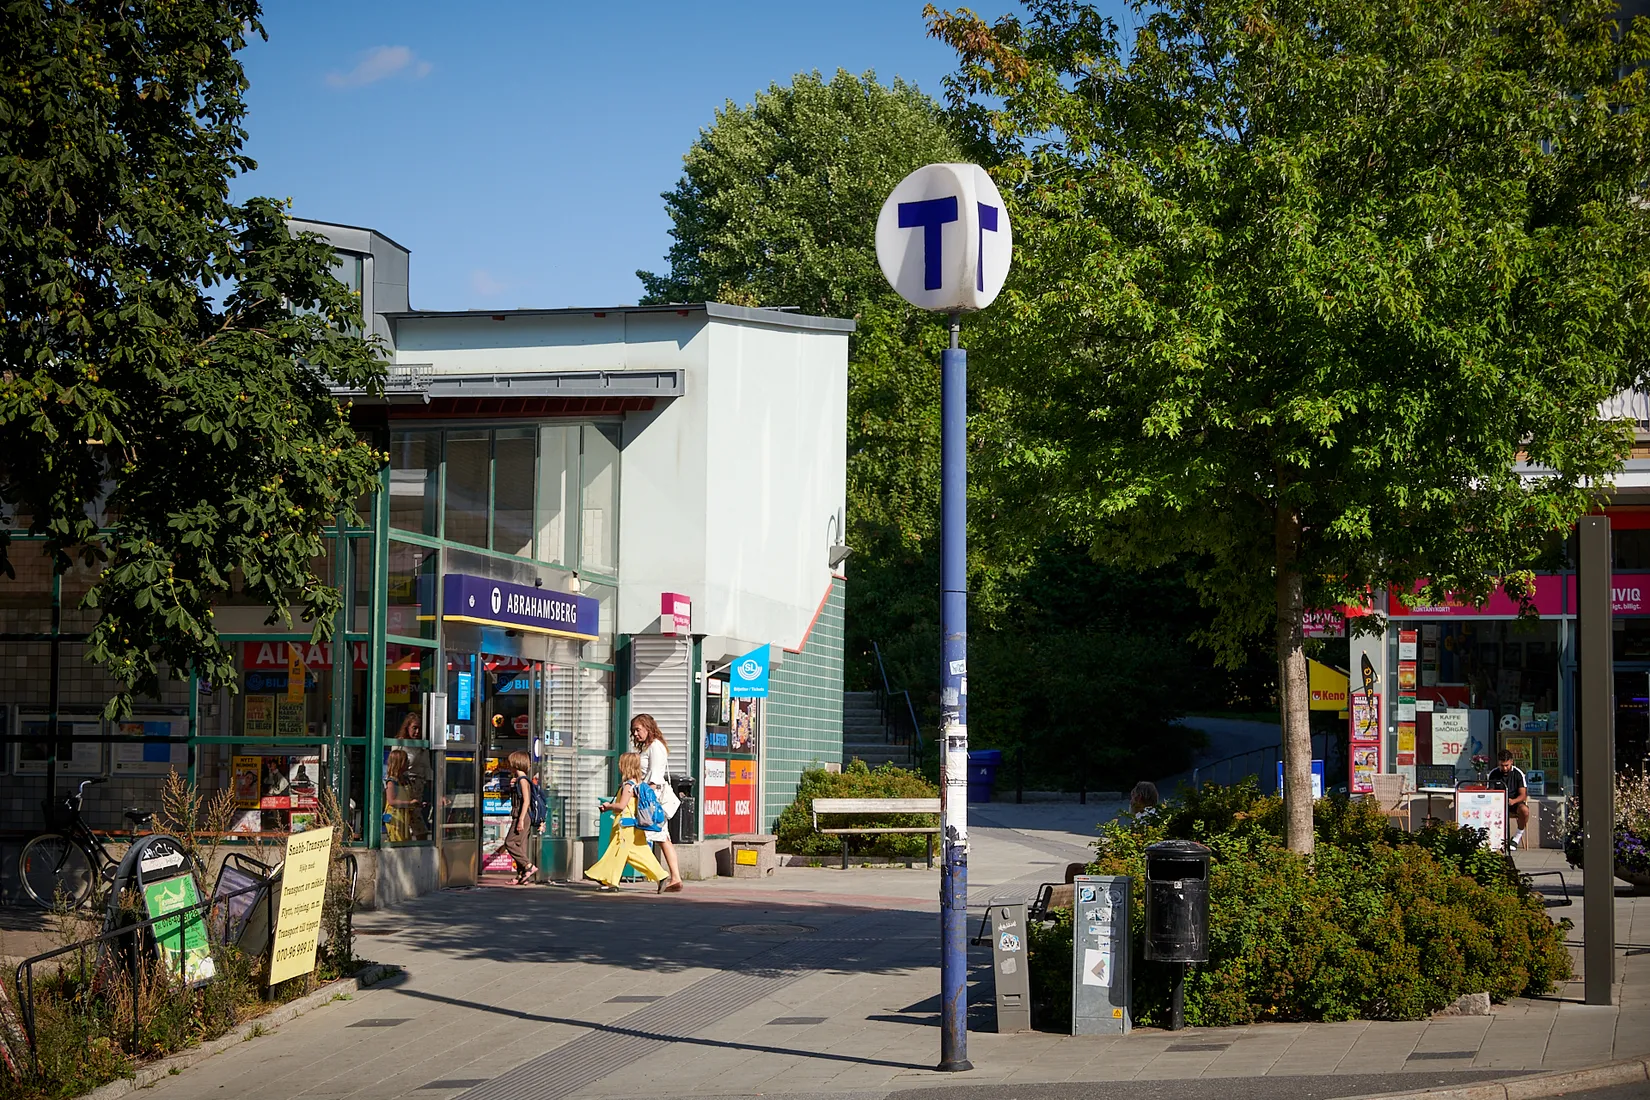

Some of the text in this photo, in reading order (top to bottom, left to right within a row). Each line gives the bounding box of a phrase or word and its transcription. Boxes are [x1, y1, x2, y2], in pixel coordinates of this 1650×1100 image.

[898, 196, 958, 290] T
[977, 201, 998, 292] T
[507, 593, 577, 623] ABRAHAMSBERG
[744, 663, 755, 672] SL
[1322, 690, 1346, 701] Keno
[1442, 742, 1467, 755] 30:-
[734, 800, 751, 816] KIOSK
[288, 837, 330, 857] Snabb-Transport
[284, 882, 305, 897] Transport
[311, 878, 325, 890] möbler
[277, 925, 299, 940] Transport
[306, 920, 319, 932] tippen
[276, 939, 315, 962] 070-96 999 13
